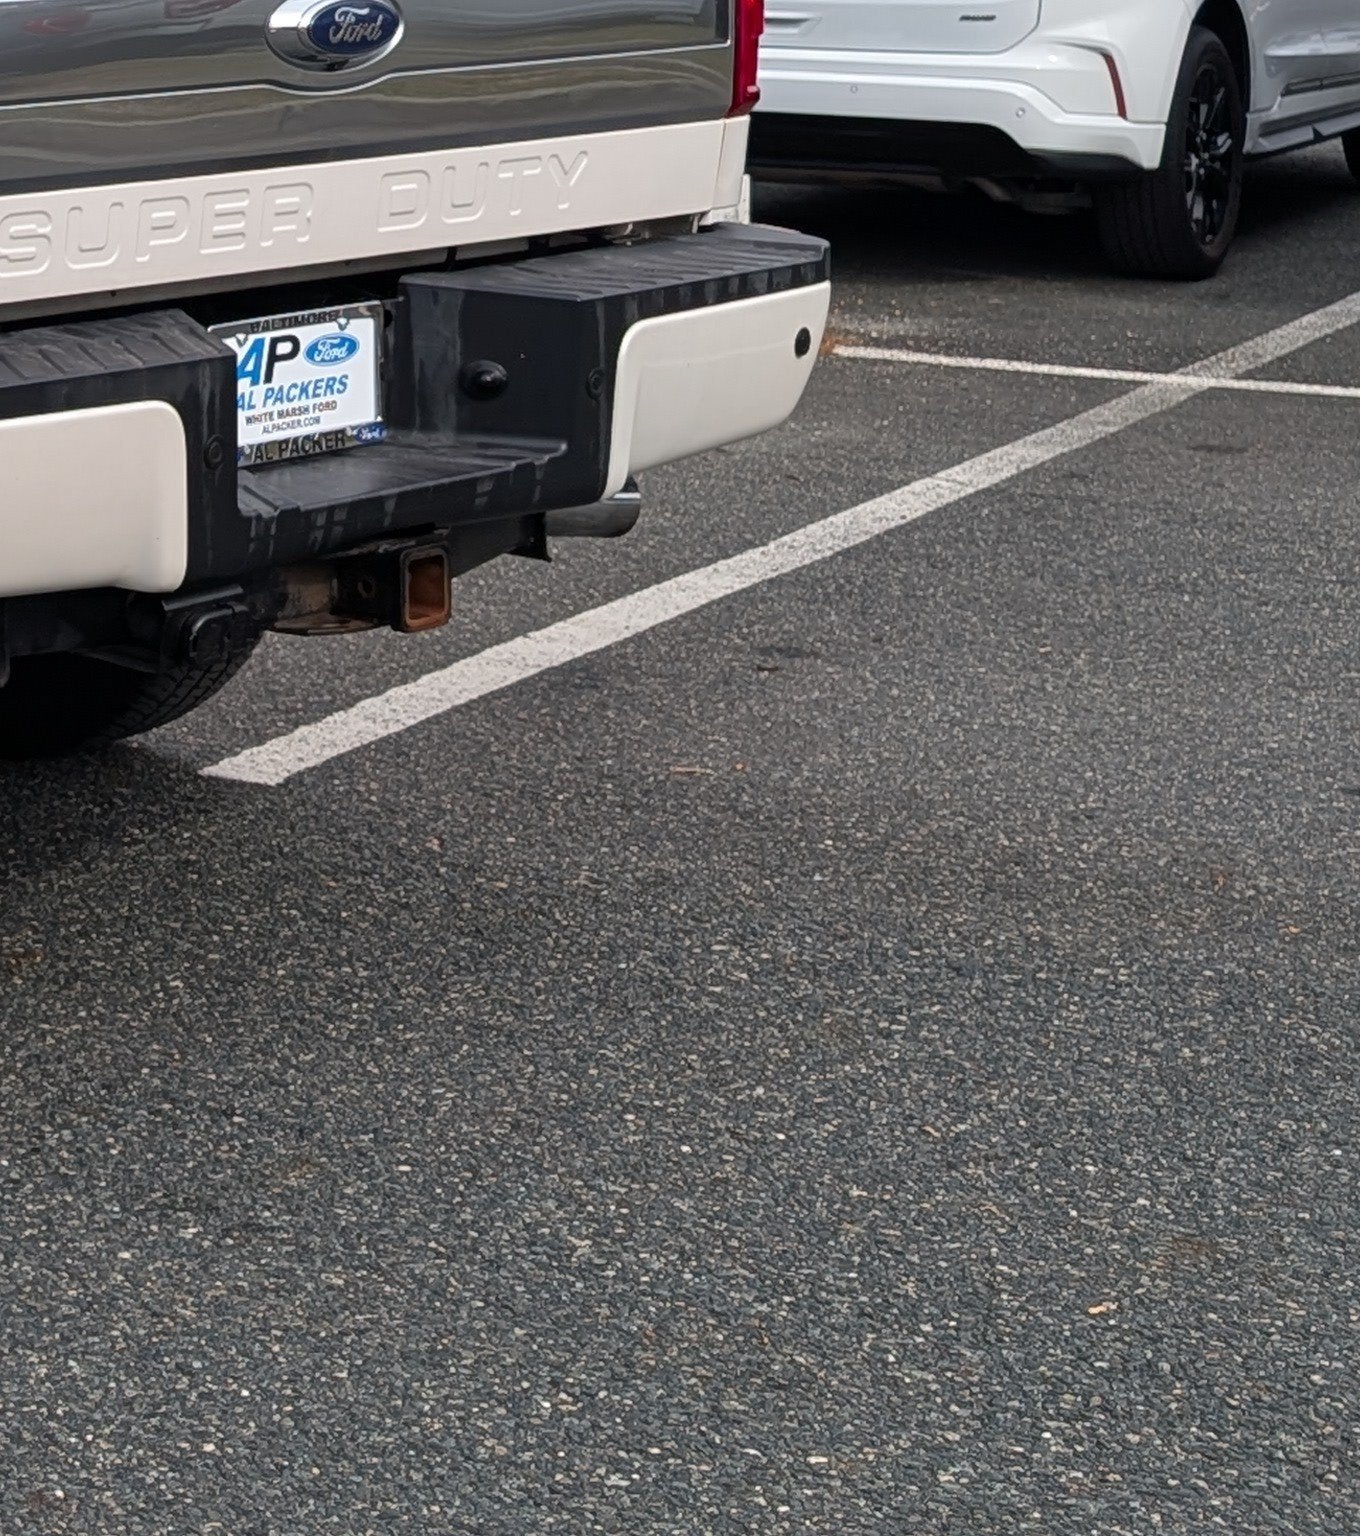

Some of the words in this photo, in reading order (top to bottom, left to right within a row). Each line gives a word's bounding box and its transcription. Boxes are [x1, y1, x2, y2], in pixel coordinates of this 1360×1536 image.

[328, 6, 384, 44] Ford
[377, 150, 589, 233] DUTY
[237, 334, 301, 387] AP
[313, 337, 351, 362] Ford
[237, 390, 257, 412] AL
[261, 374, 349, 408] PACKERS
[245, 411, 274, 426] WHITE
[277, 404, 310, 419] MARSH
[312, 400, 338, 414] FORD
[253, 444, 274, 463] AL
[278, 428, 346, 458] PACKER
